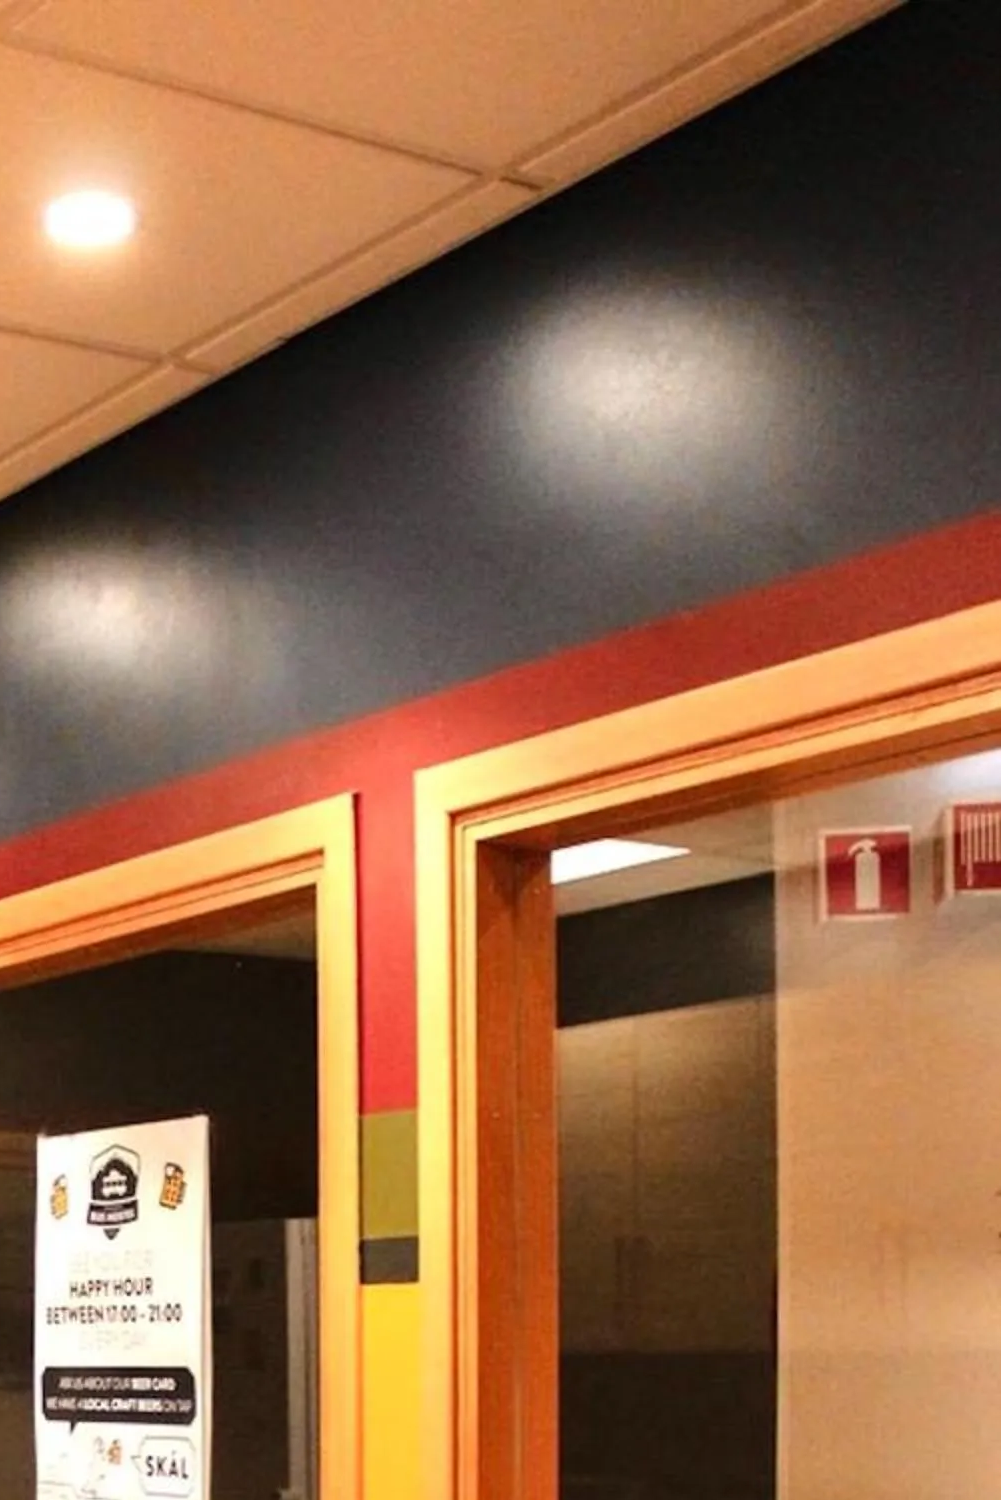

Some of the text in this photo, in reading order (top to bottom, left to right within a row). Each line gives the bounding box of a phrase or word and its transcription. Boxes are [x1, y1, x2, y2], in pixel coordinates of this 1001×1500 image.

[69, 1276, 154, 1299] HAPPY HOUR
[46, 1305, 104, 1326] BETWEEN
